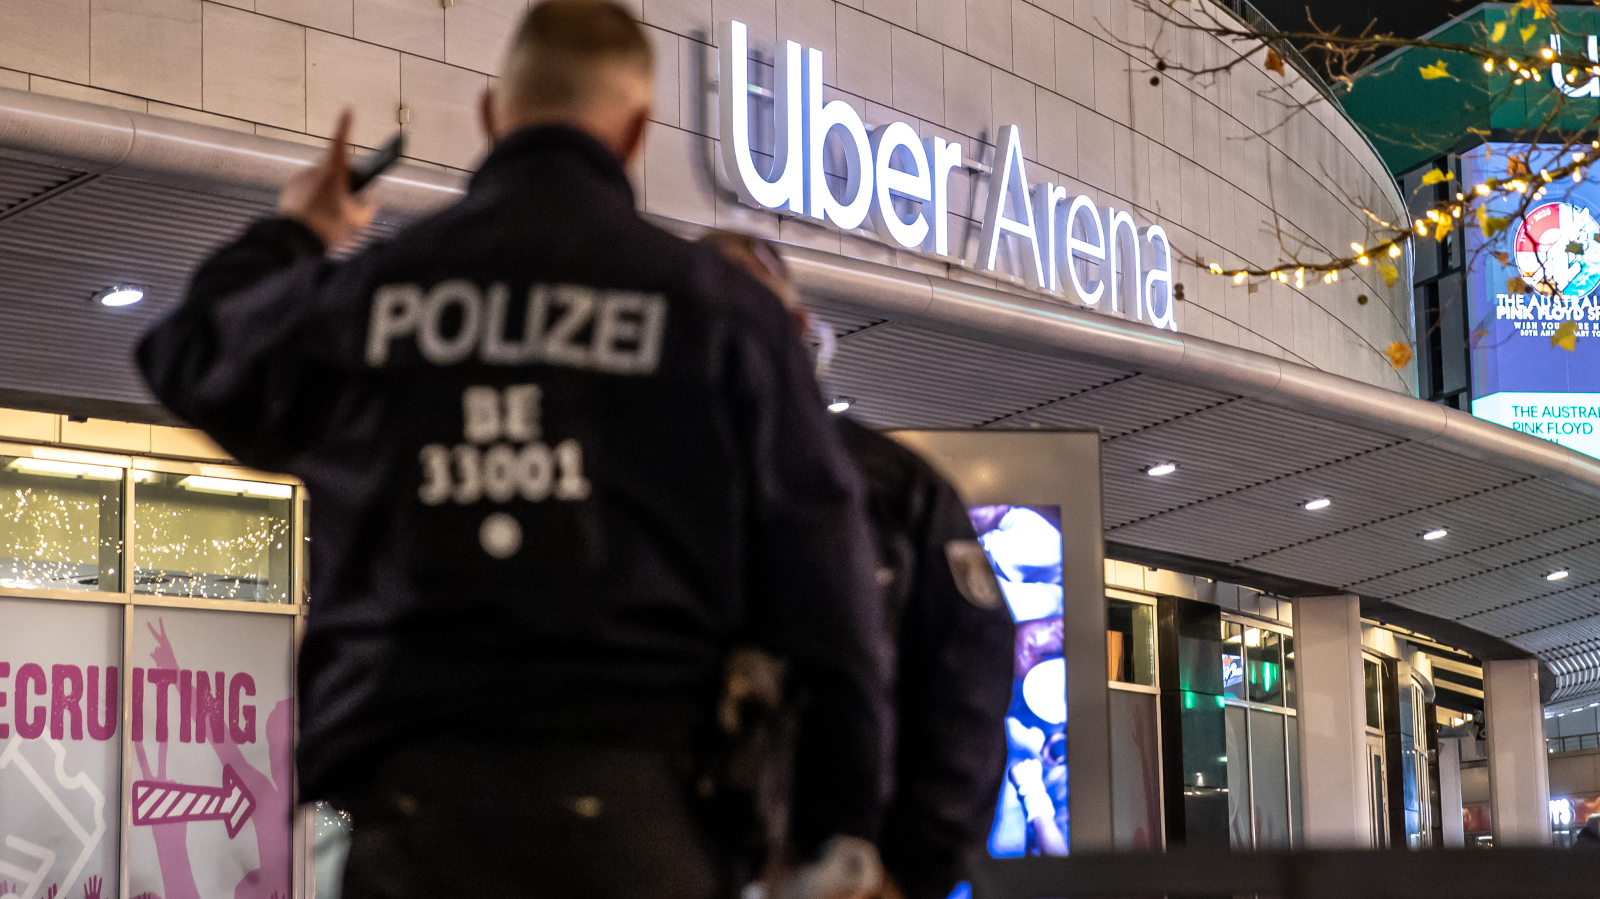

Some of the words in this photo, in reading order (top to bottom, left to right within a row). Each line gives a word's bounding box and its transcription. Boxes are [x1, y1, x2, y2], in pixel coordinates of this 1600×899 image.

[723, 20, 961, 256] Uber
[980, 123, 1178, 332] Arena
[1496, 293, 1524, 308] THE
[1496, 305, 1534, 320] PINK
[1537, 306, 1584, 321] FLOYD
[364, 279, 667, 374] POLIZEI
[1514, 321, 1538, 330] WISH
[1541, 322, 1560, 330] YOU
[1540, 330, 1590, 338] ANNARY
[462, 385, 543, 442] BE
[1511, 405, 1538, 418] THE
[1541, 405, 1600, 419] AUSTRA
[1547, 422, 1593, 435] FLOYD
